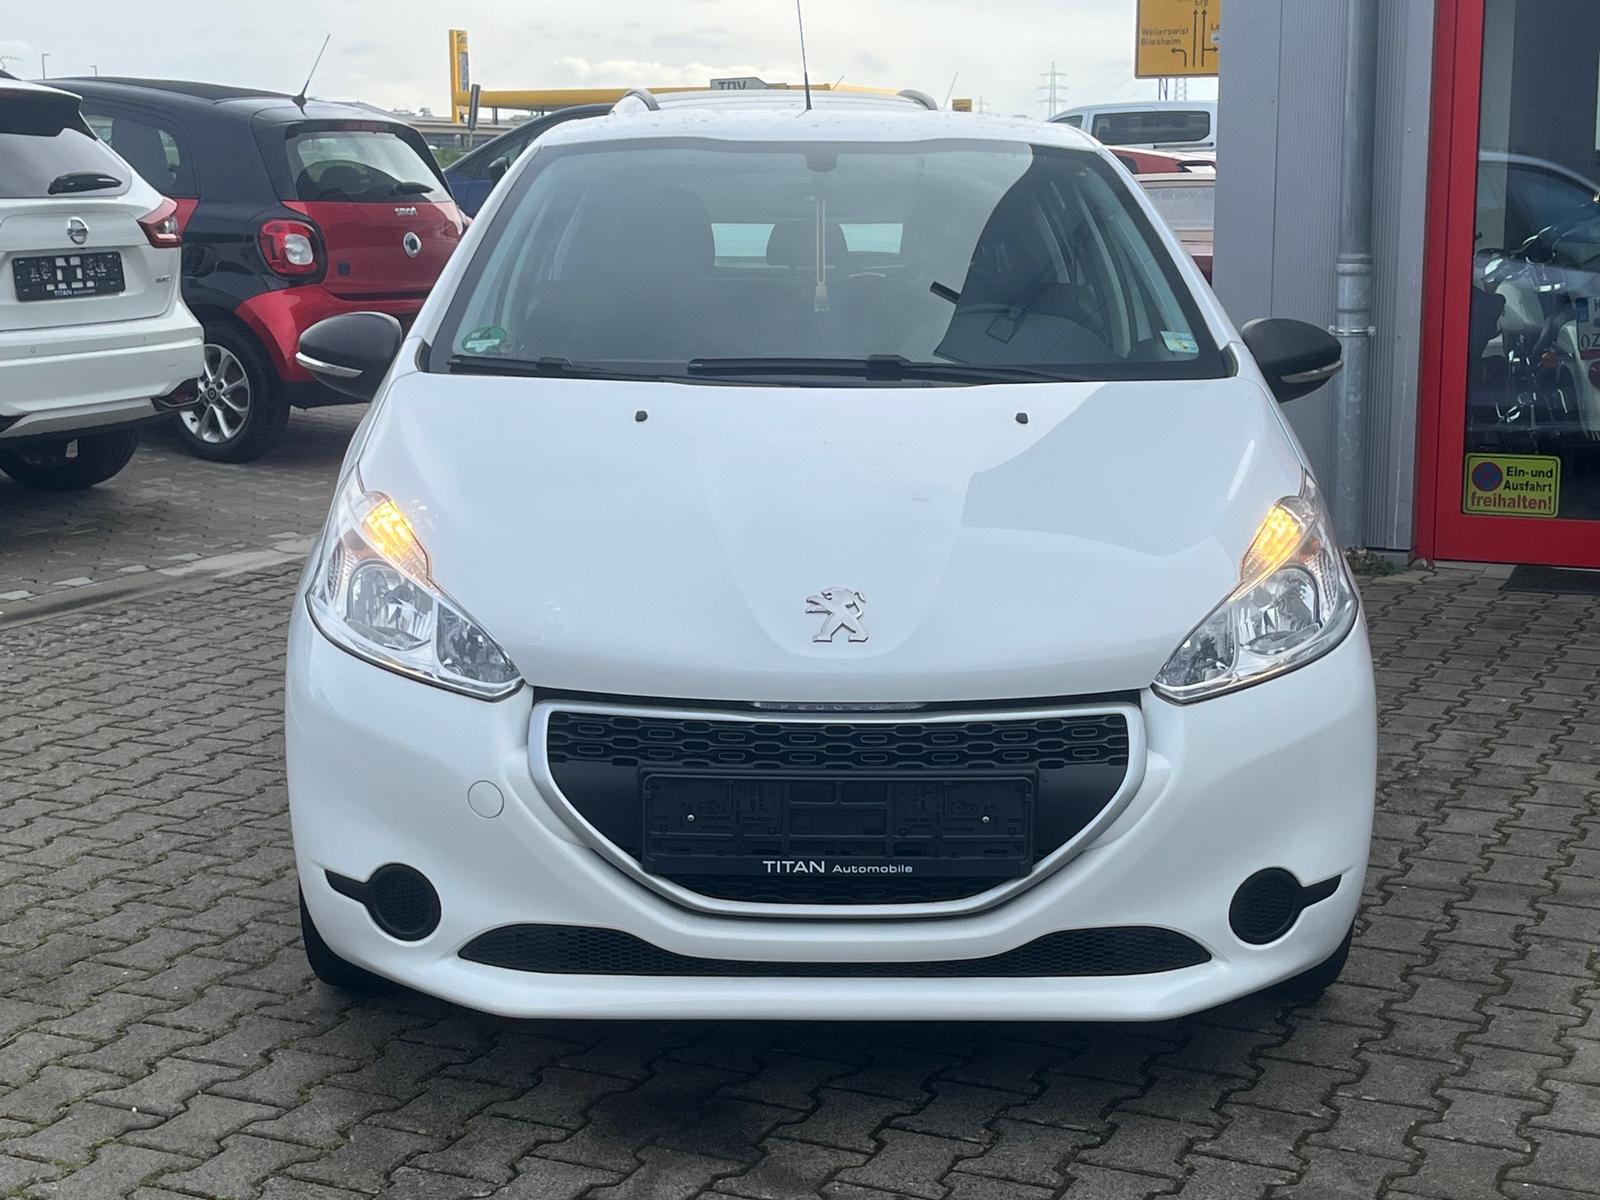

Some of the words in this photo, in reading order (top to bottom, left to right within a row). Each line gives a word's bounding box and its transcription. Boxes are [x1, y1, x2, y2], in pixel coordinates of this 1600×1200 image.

[1140, 37, 1181, 46] Bliesheim
[54, 289, 73, 297] TITAN
[1503, 480, 1552, 492] Ausfahrt
[1471, 492, 1552, 512] freihalten!
[762, 860, 825, 873] TITAN
[832, 864, 913, 873] Automobile
